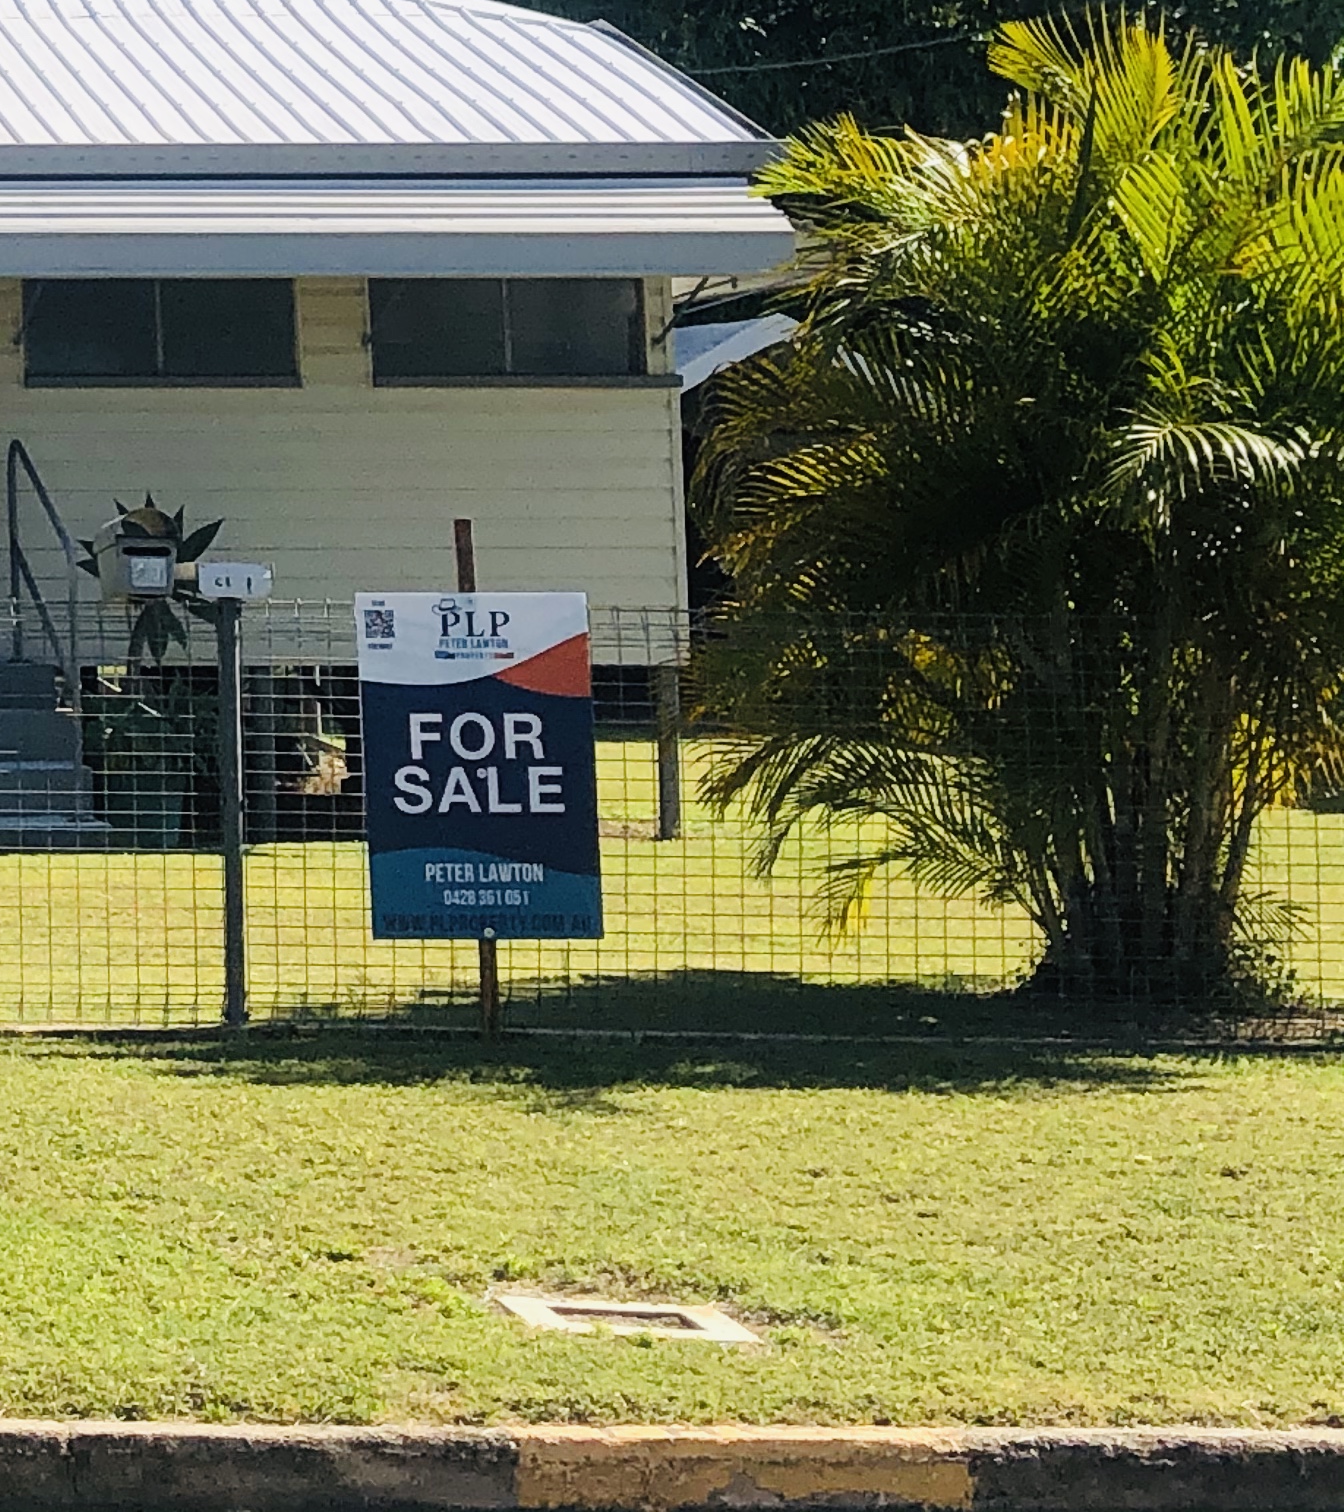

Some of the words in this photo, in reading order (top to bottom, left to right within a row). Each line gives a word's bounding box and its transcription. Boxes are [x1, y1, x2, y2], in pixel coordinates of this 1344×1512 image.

[440, 611, 510, 637] PLP
[439, 638, 467, 648] PETER
[471, 638, 508, 648] LAWTON
[409, 712, 545, 760] FOR
[393, 765, 566, 814] SALE
[425, 863, 474, 882] PETER
[479, 863, 544, 882] LAWTON
[443, 890, 476, 905] 0428
[479, 890, 502, 905] 361
[505, 890, 529, 905] 051
